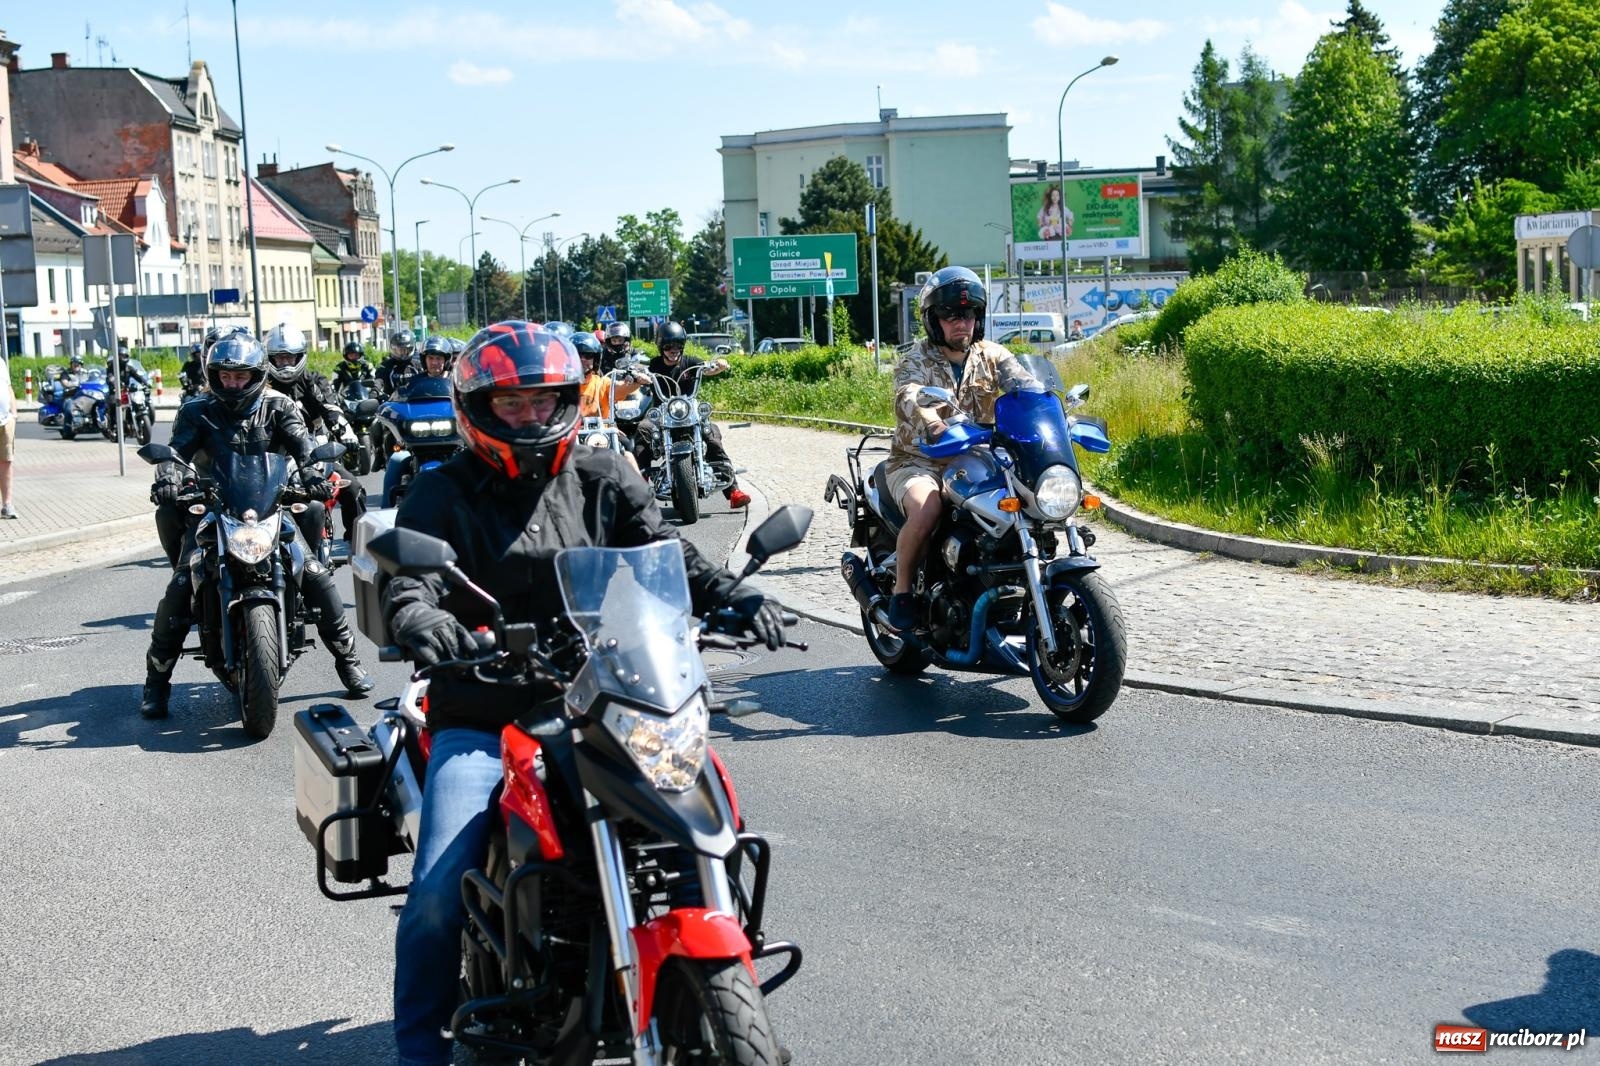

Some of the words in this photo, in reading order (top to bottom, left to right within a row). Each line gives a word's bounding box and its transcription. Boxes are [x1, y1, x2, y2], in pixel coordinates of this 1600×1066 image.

[769, 239, 798, 249] Rybnik
[769, 250, 801, 258] Gliwice
[795, 260, 818, 268] Miejski
[772, 271, 806, 280] Starostwo
[770, 285, 797, 295] Opole
